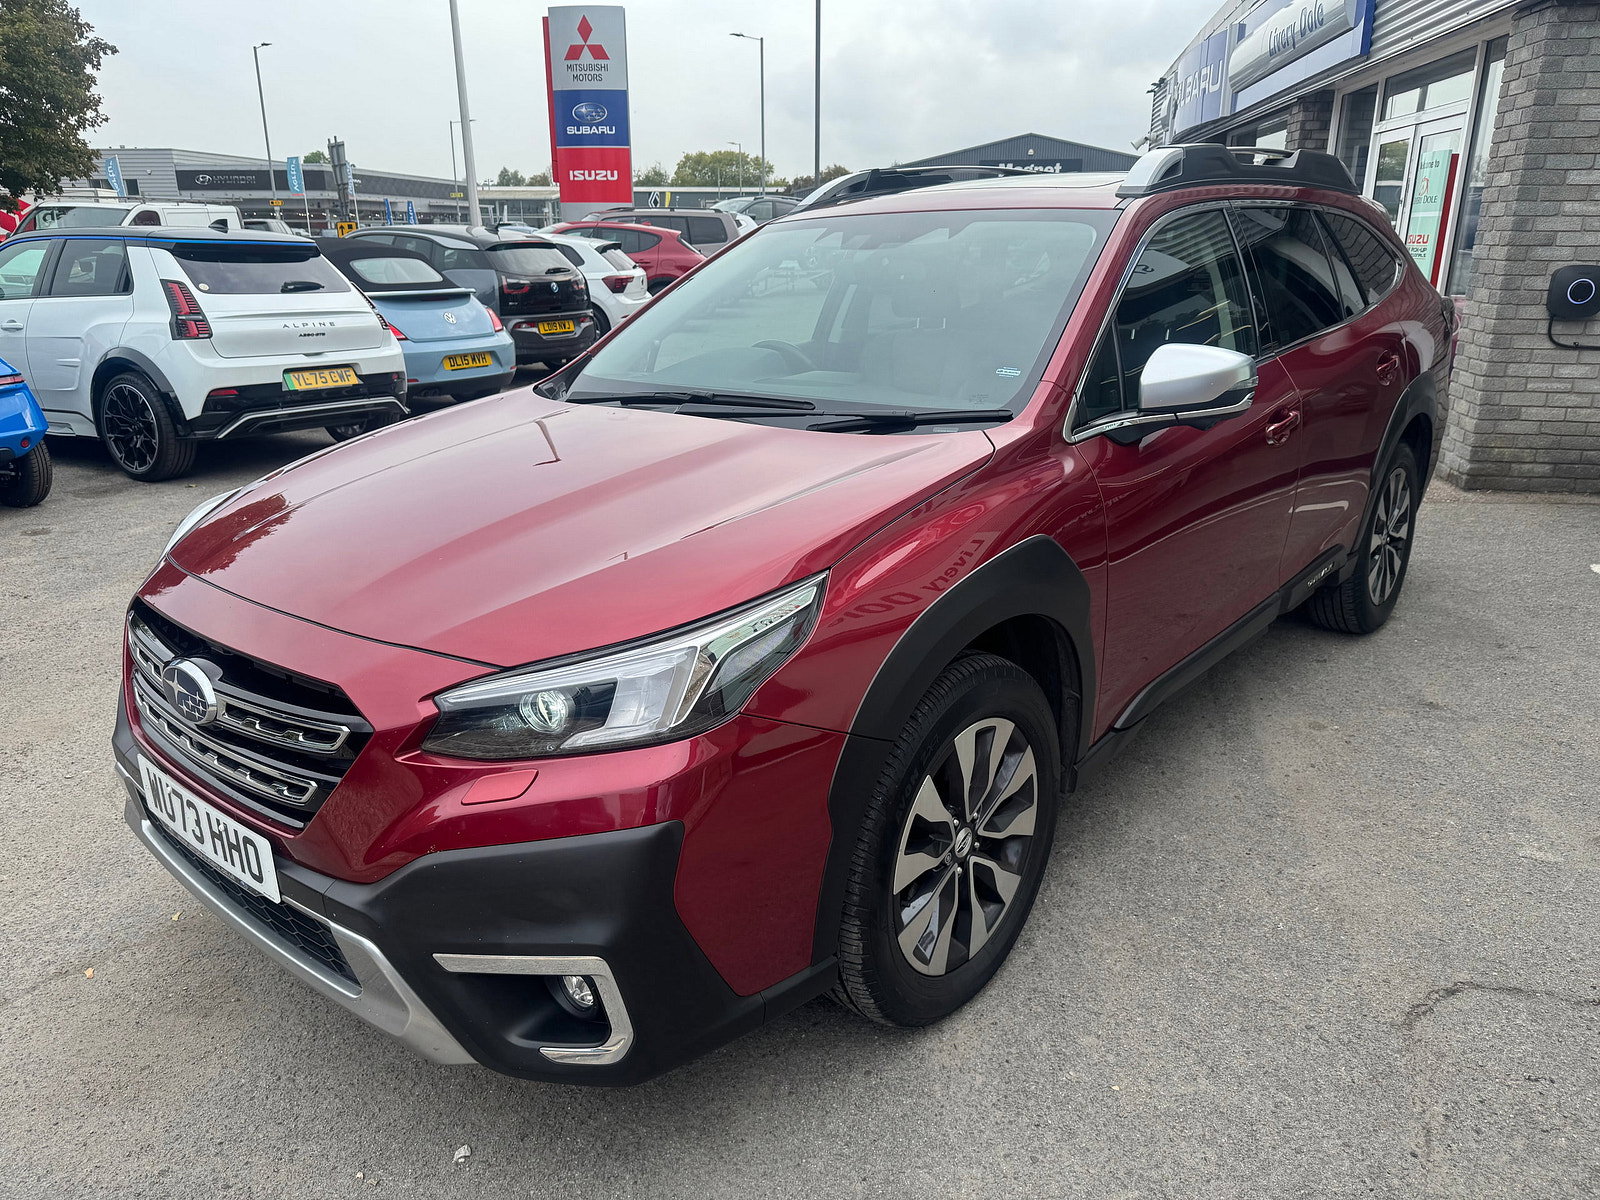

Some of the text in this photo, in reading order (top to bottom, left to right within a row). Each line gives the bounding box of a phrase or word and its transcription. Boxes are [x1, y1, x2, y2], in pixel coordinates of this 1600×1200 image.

[1268, 0, 1325, 57] Livery Dole
[566, 63, 609, 72] MITSUBISHI
[572, 73, 603, 82] MOTORS
[566, 126, 616, 135] SUBARU
[212, 175, 256, 184] HYUNDAI
[569, 170, 618, 181] ISUZU
[1408, 234, 1429, 244] SUZU
[448, 355, 470, 367] DL15
[292, 369, 352, 387] YL75 CWF
[146, 767, 205, 845] WU73
[206, 811, 264, 884] HHO
